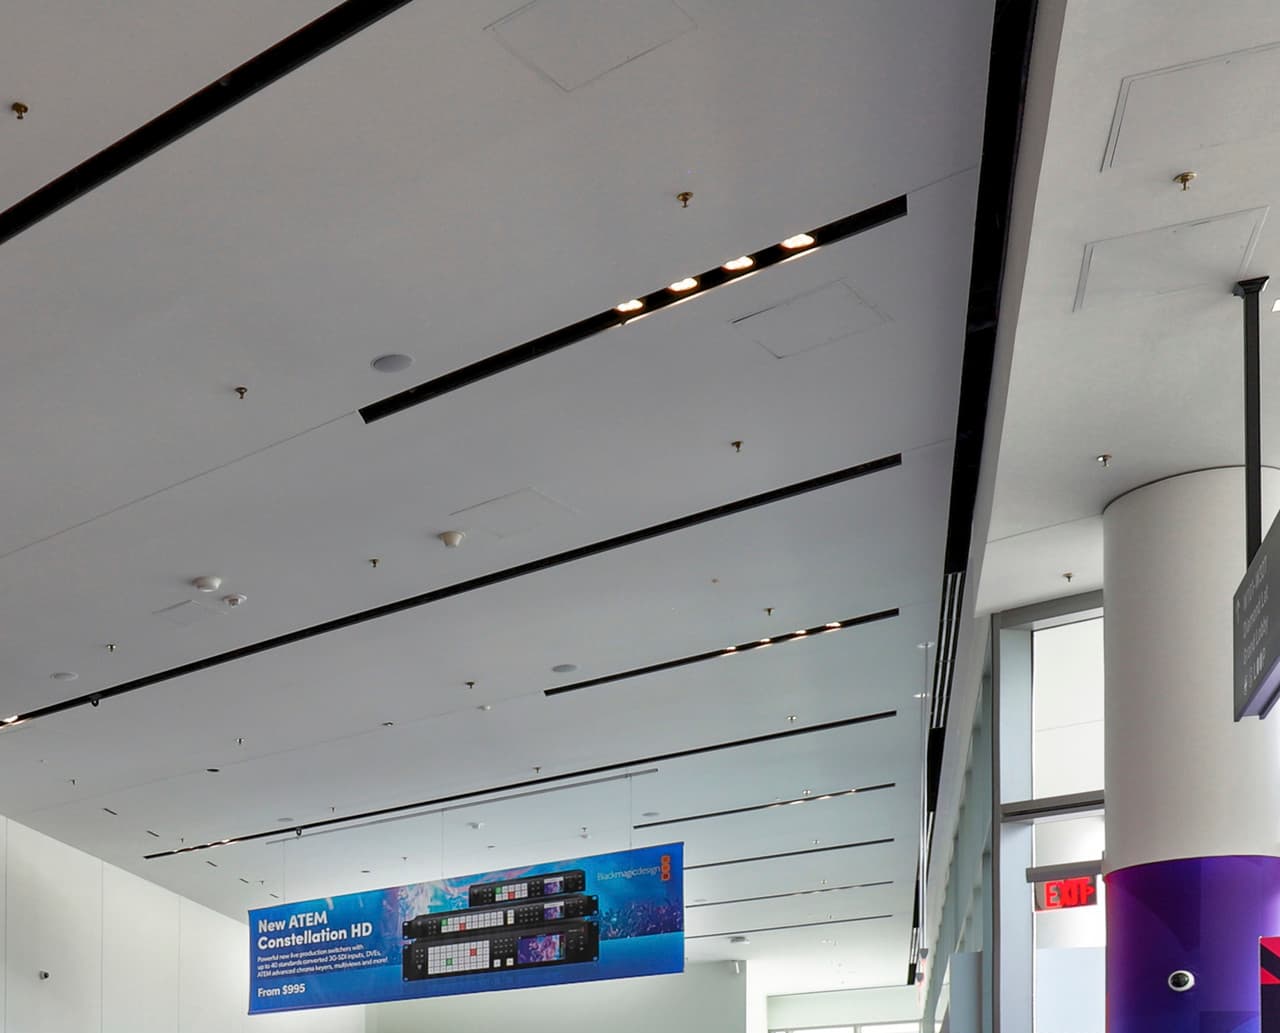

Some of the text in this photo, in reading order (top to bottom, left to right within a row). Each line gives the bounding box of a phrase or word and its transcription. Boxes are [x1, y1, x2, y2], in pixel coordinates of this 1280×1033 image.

[258, 911, 328, 933] New ATEM
[258, 922, 373, 950] Constellation HD
[258, 983, 306, 998] From $995
